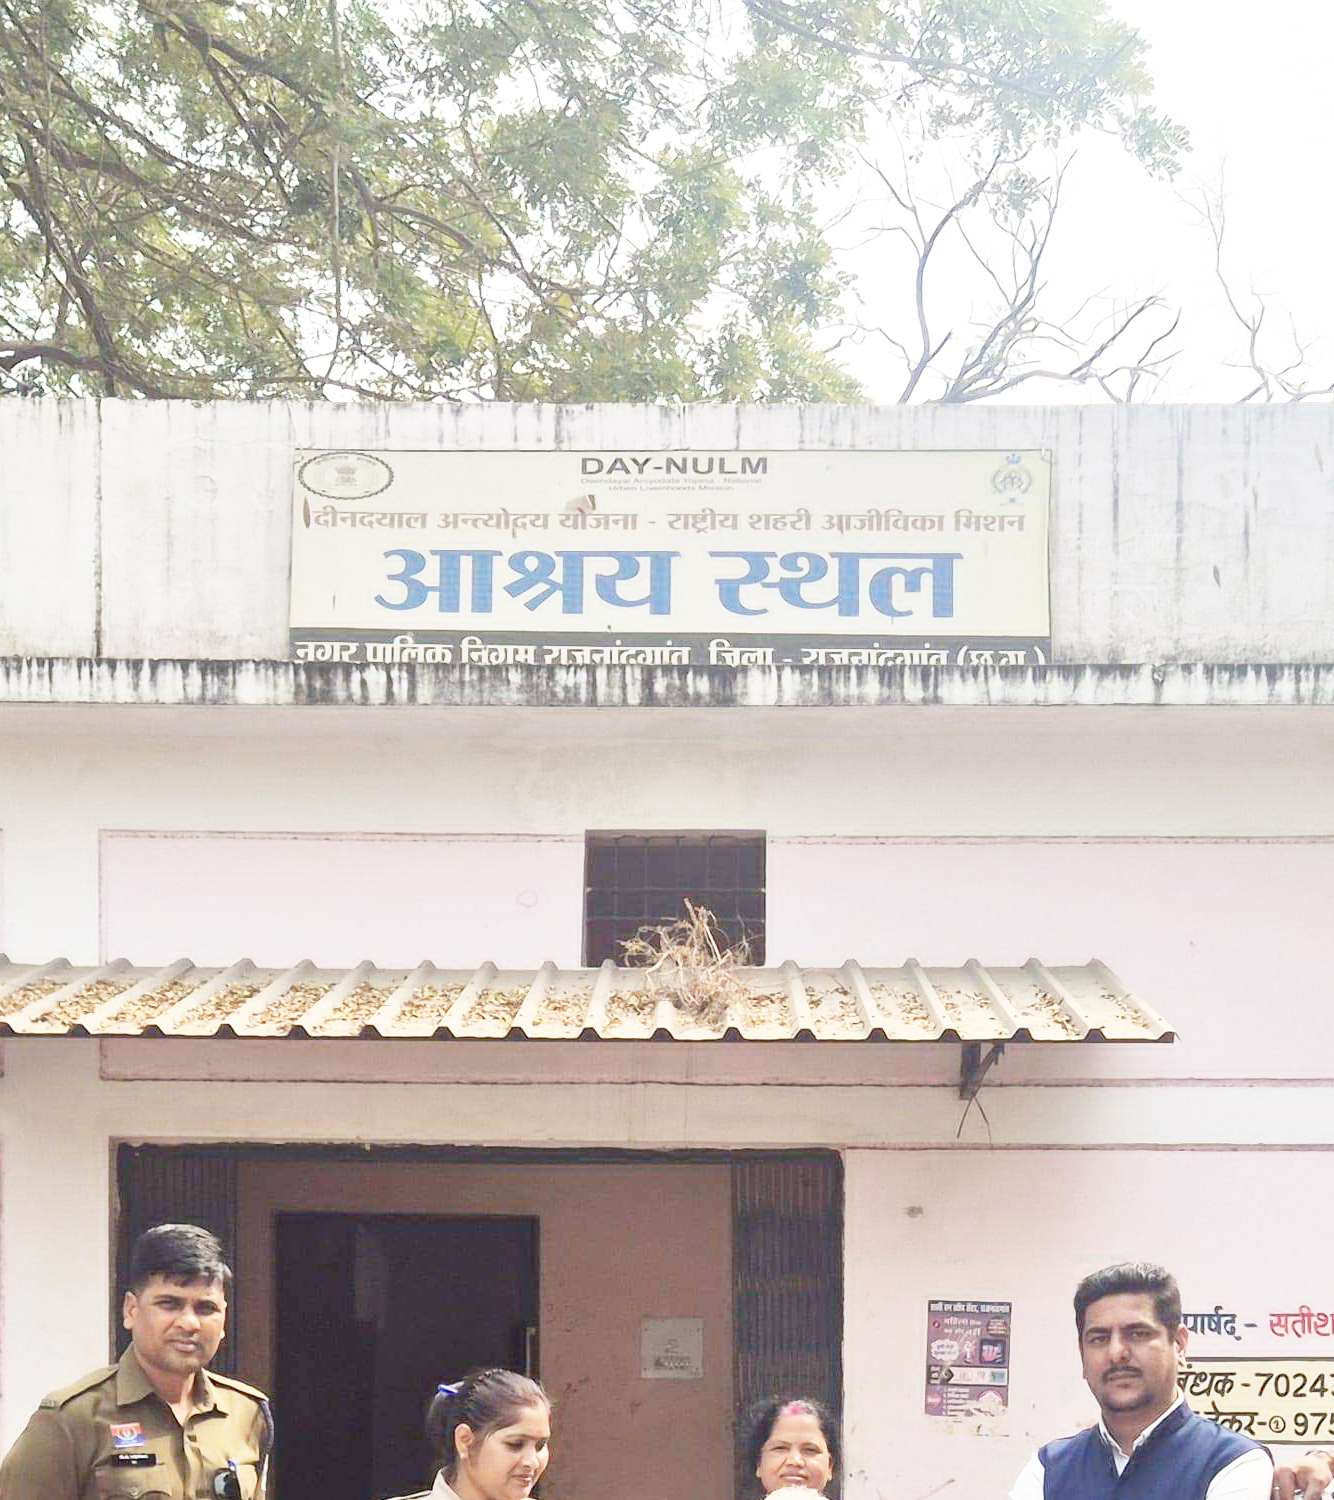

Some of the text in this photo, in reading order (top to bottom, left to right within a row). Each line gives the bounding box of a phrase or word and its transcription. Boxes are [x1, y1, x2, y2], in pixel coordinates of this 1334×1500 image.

[581, 457, 767, 475] DAY-NULM
[312, 505, 428, 530] दीनदयाल
[558, 507, 638, 530] योजना
[667, 508, 739, 534] राष्ट्रीय
[747, 507, 812, 531] शहरी
[821, 508, 945, 533] आजीविका
[953, 508, 1026, 532] मिशन
[374, 548, 964, 618] आश्रय स्थल
[295, 640, 359, 664] नगर
[460, 636, 536, 665] निगम
[1176, 1363, 1237, 1397] बंधक
